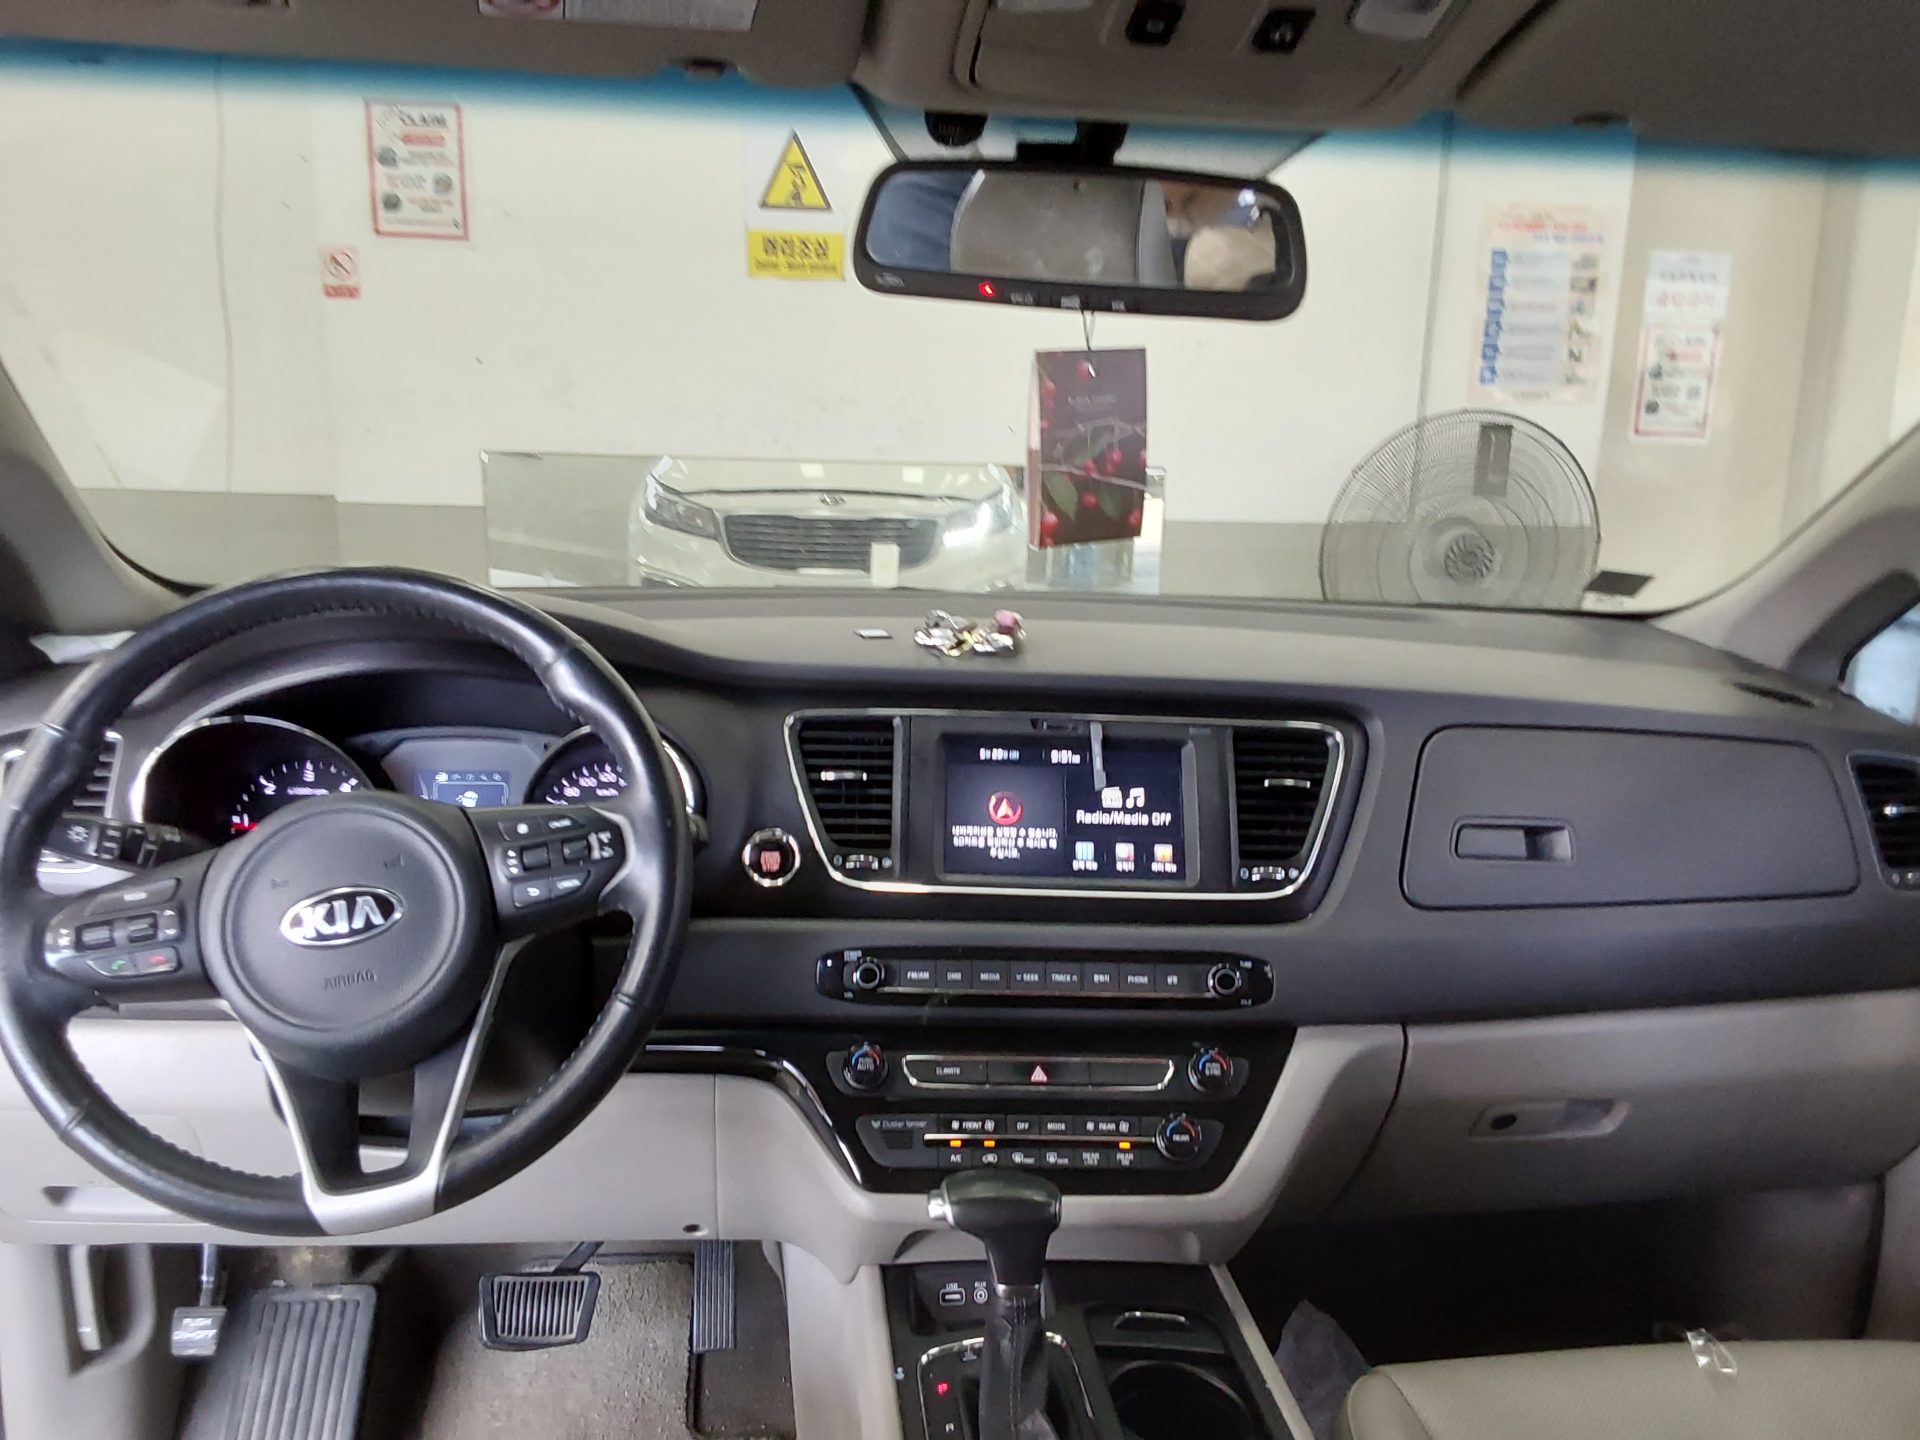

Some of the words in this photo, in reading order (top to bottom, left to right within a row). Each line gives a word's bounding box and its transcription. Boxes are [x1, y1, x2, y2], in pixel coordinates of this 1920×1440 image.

[1076, 809, 1150, 826] Radio/Media
[1151, 811, 1172, 827] Off
[298, 895, 386, 939] KIA
[323, 968, 377, 990] AIRBAG
[962, 1121, 982, 1130] FRONT
[1016, 1121, 1030, 1130] OFF
[1047, 1122, 1066, 1131] MODE
[946, 1282, 959, 1290] USB
